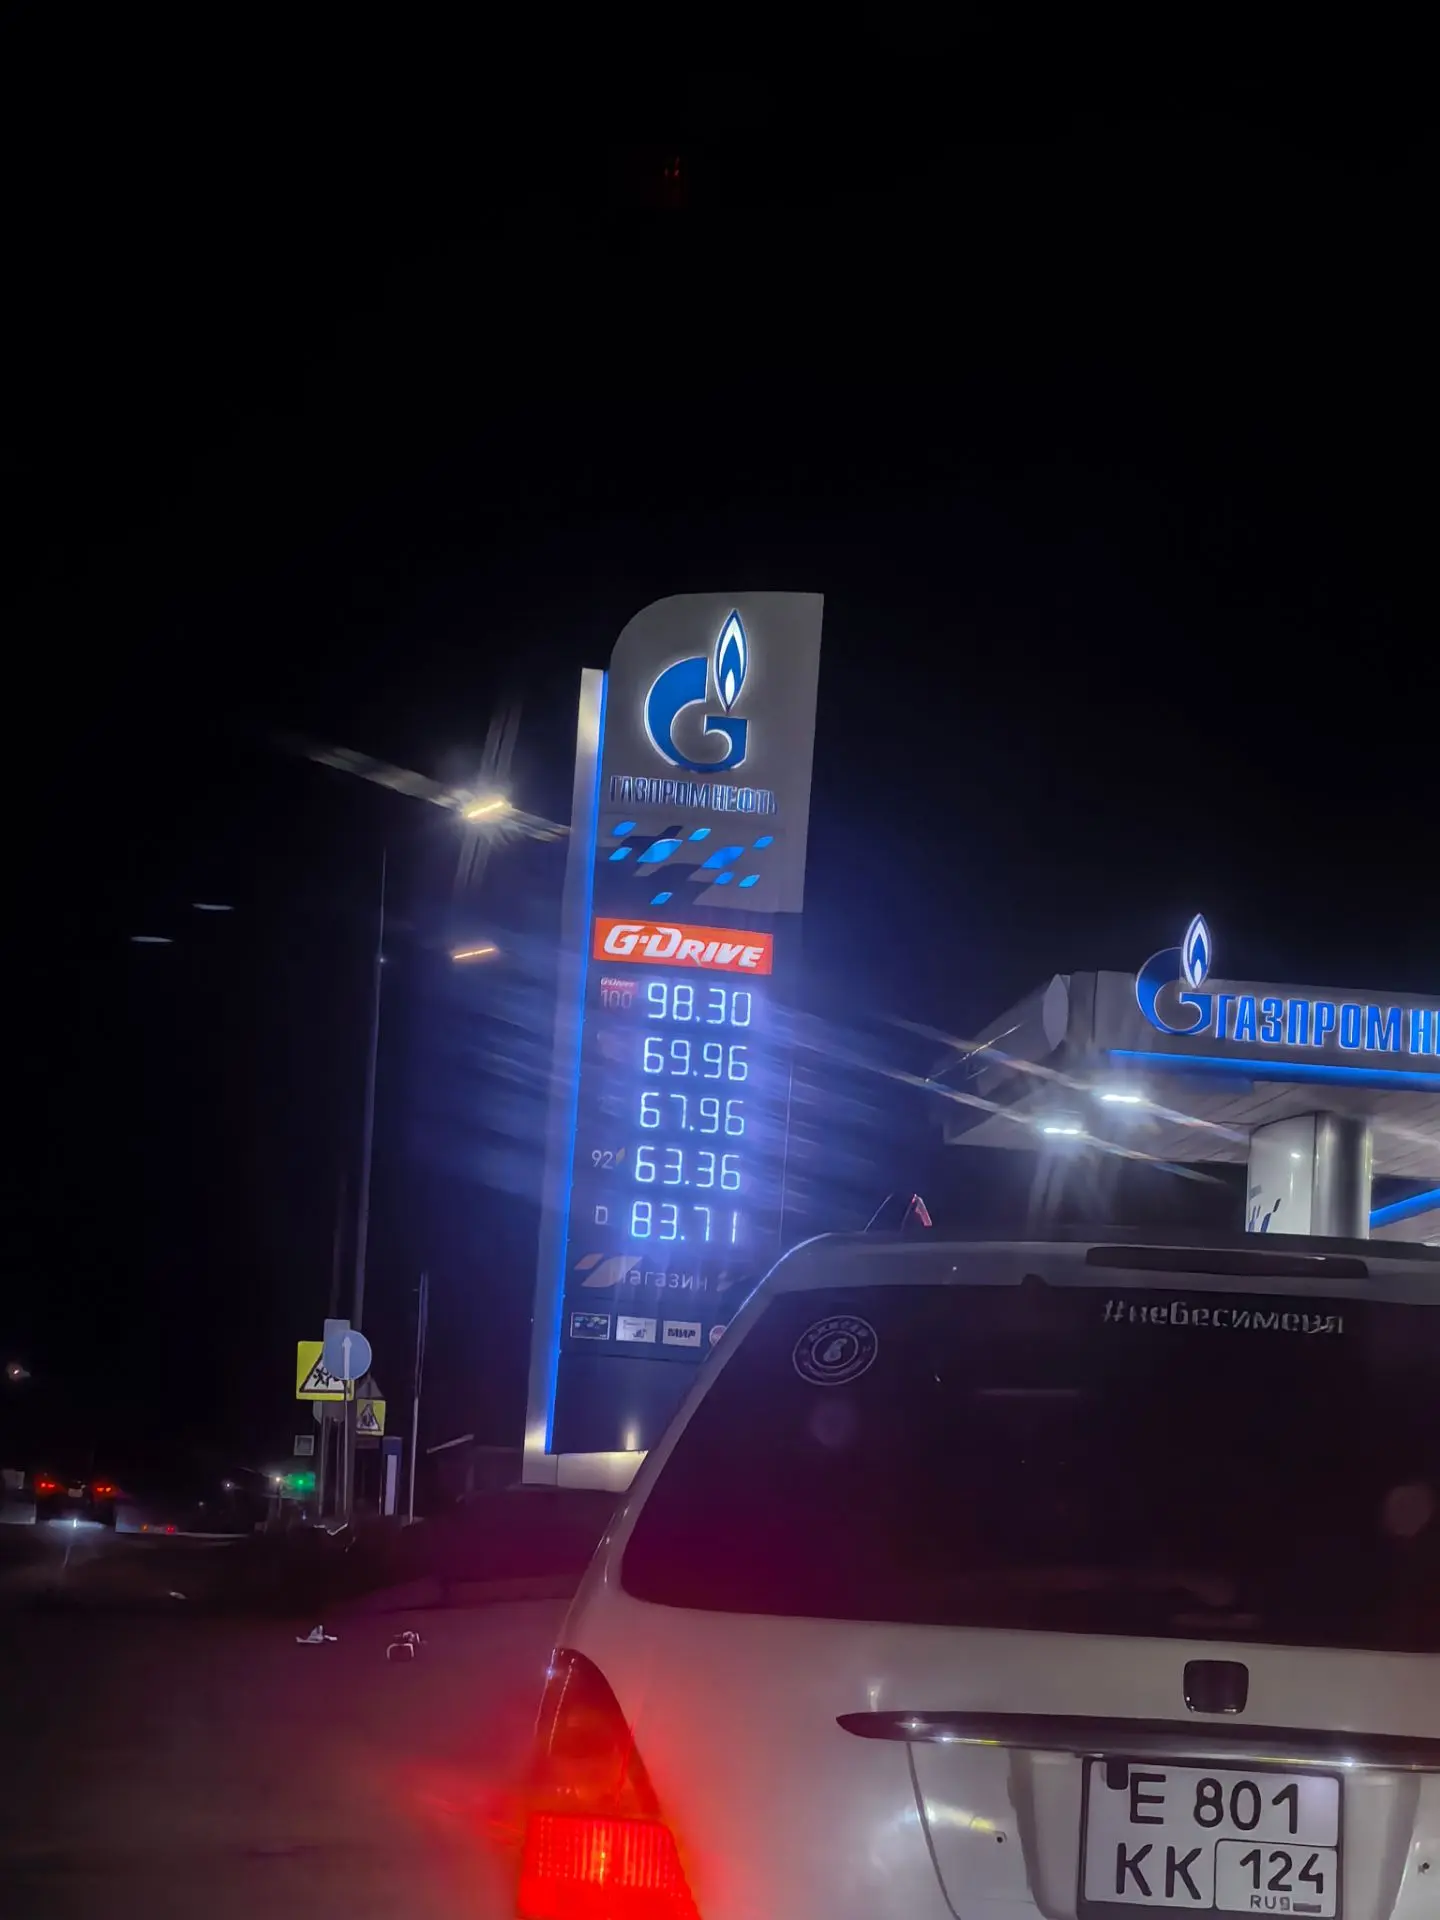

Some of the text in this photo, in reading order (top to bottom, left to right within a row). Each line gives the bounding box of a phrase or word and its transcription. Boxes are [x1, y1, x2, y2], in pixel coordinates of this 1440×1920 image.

[602, 982, 752, 1027] 100 98.30
[643, 1036, 749, 1082] 69.96
[639, 1091, 745, 1136] 67.96
[591, 1145, 741, 1191] 92 63.36
[630, 1200, 739, 1244] 83.71
[1192, 1777, 1299, 1834] 801
[1239, 1848, 1324, 1894] 124
